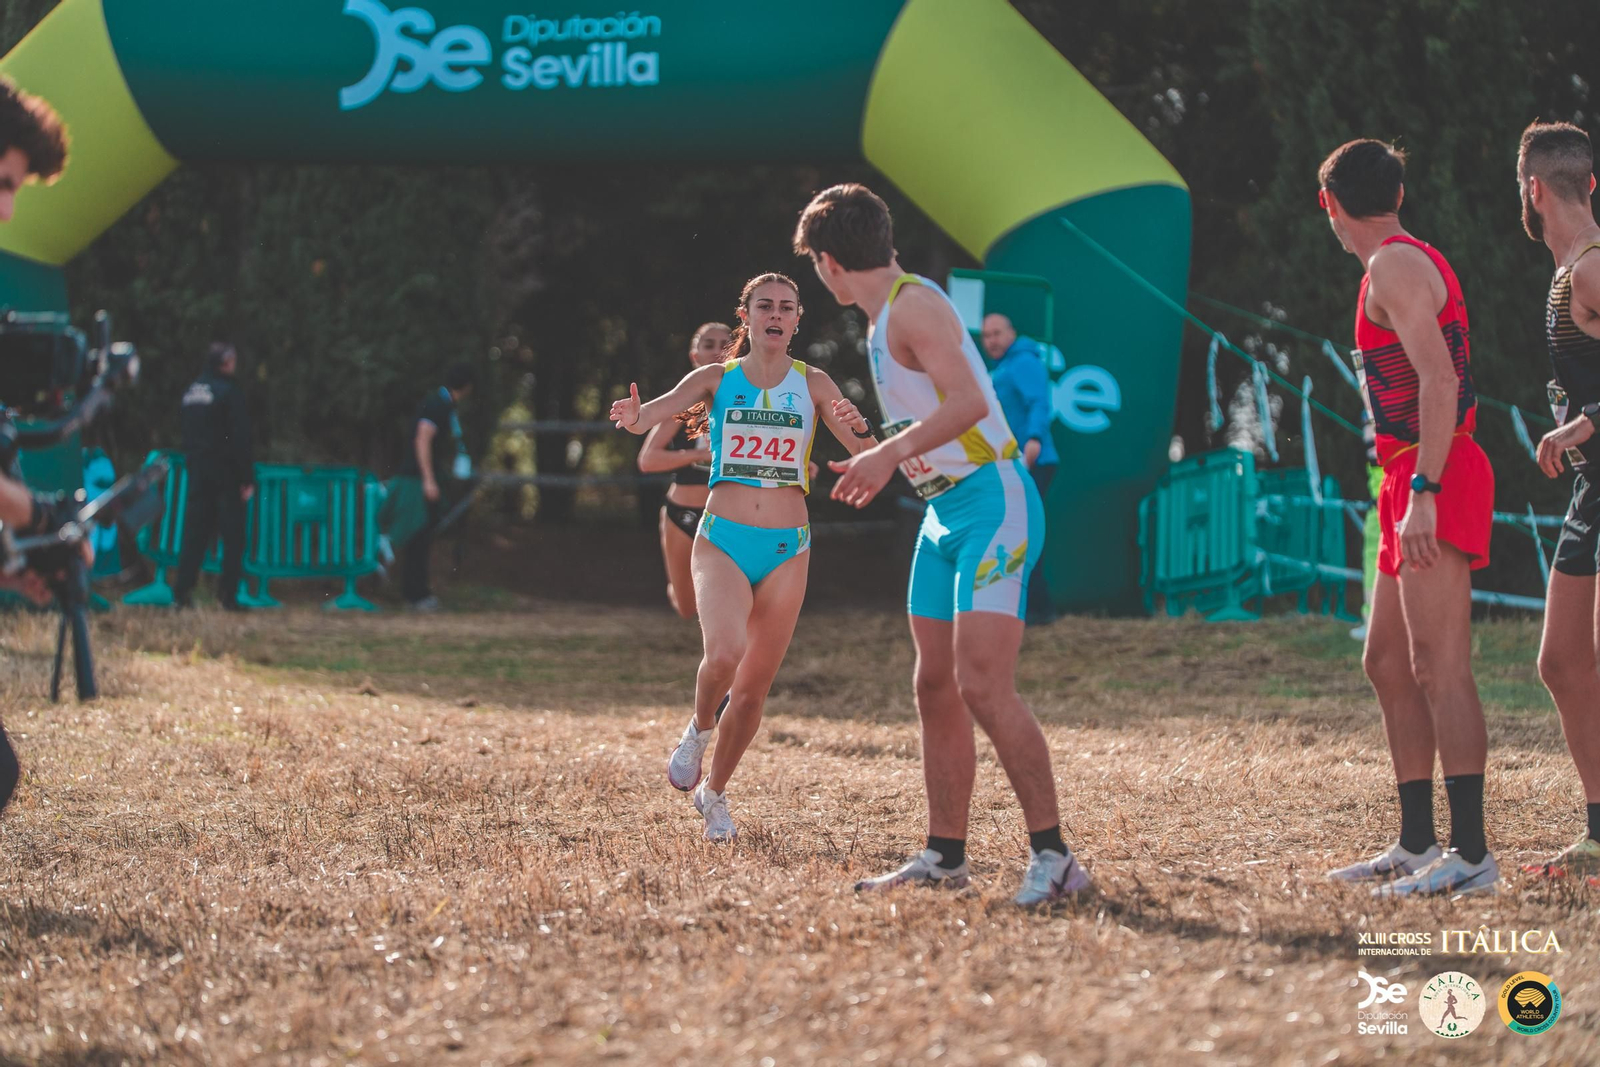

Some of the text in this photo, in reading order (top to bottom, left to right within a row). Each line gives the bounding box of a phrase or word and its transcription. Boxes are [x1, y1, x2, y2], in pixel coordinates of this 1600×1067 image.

[502, 11, 661, 46] Diputación
[501, 41, 660, 90] Sevilla
[747, 410, 785, 422] ITÁLICA
[729, 435, 796, 462] 2242
